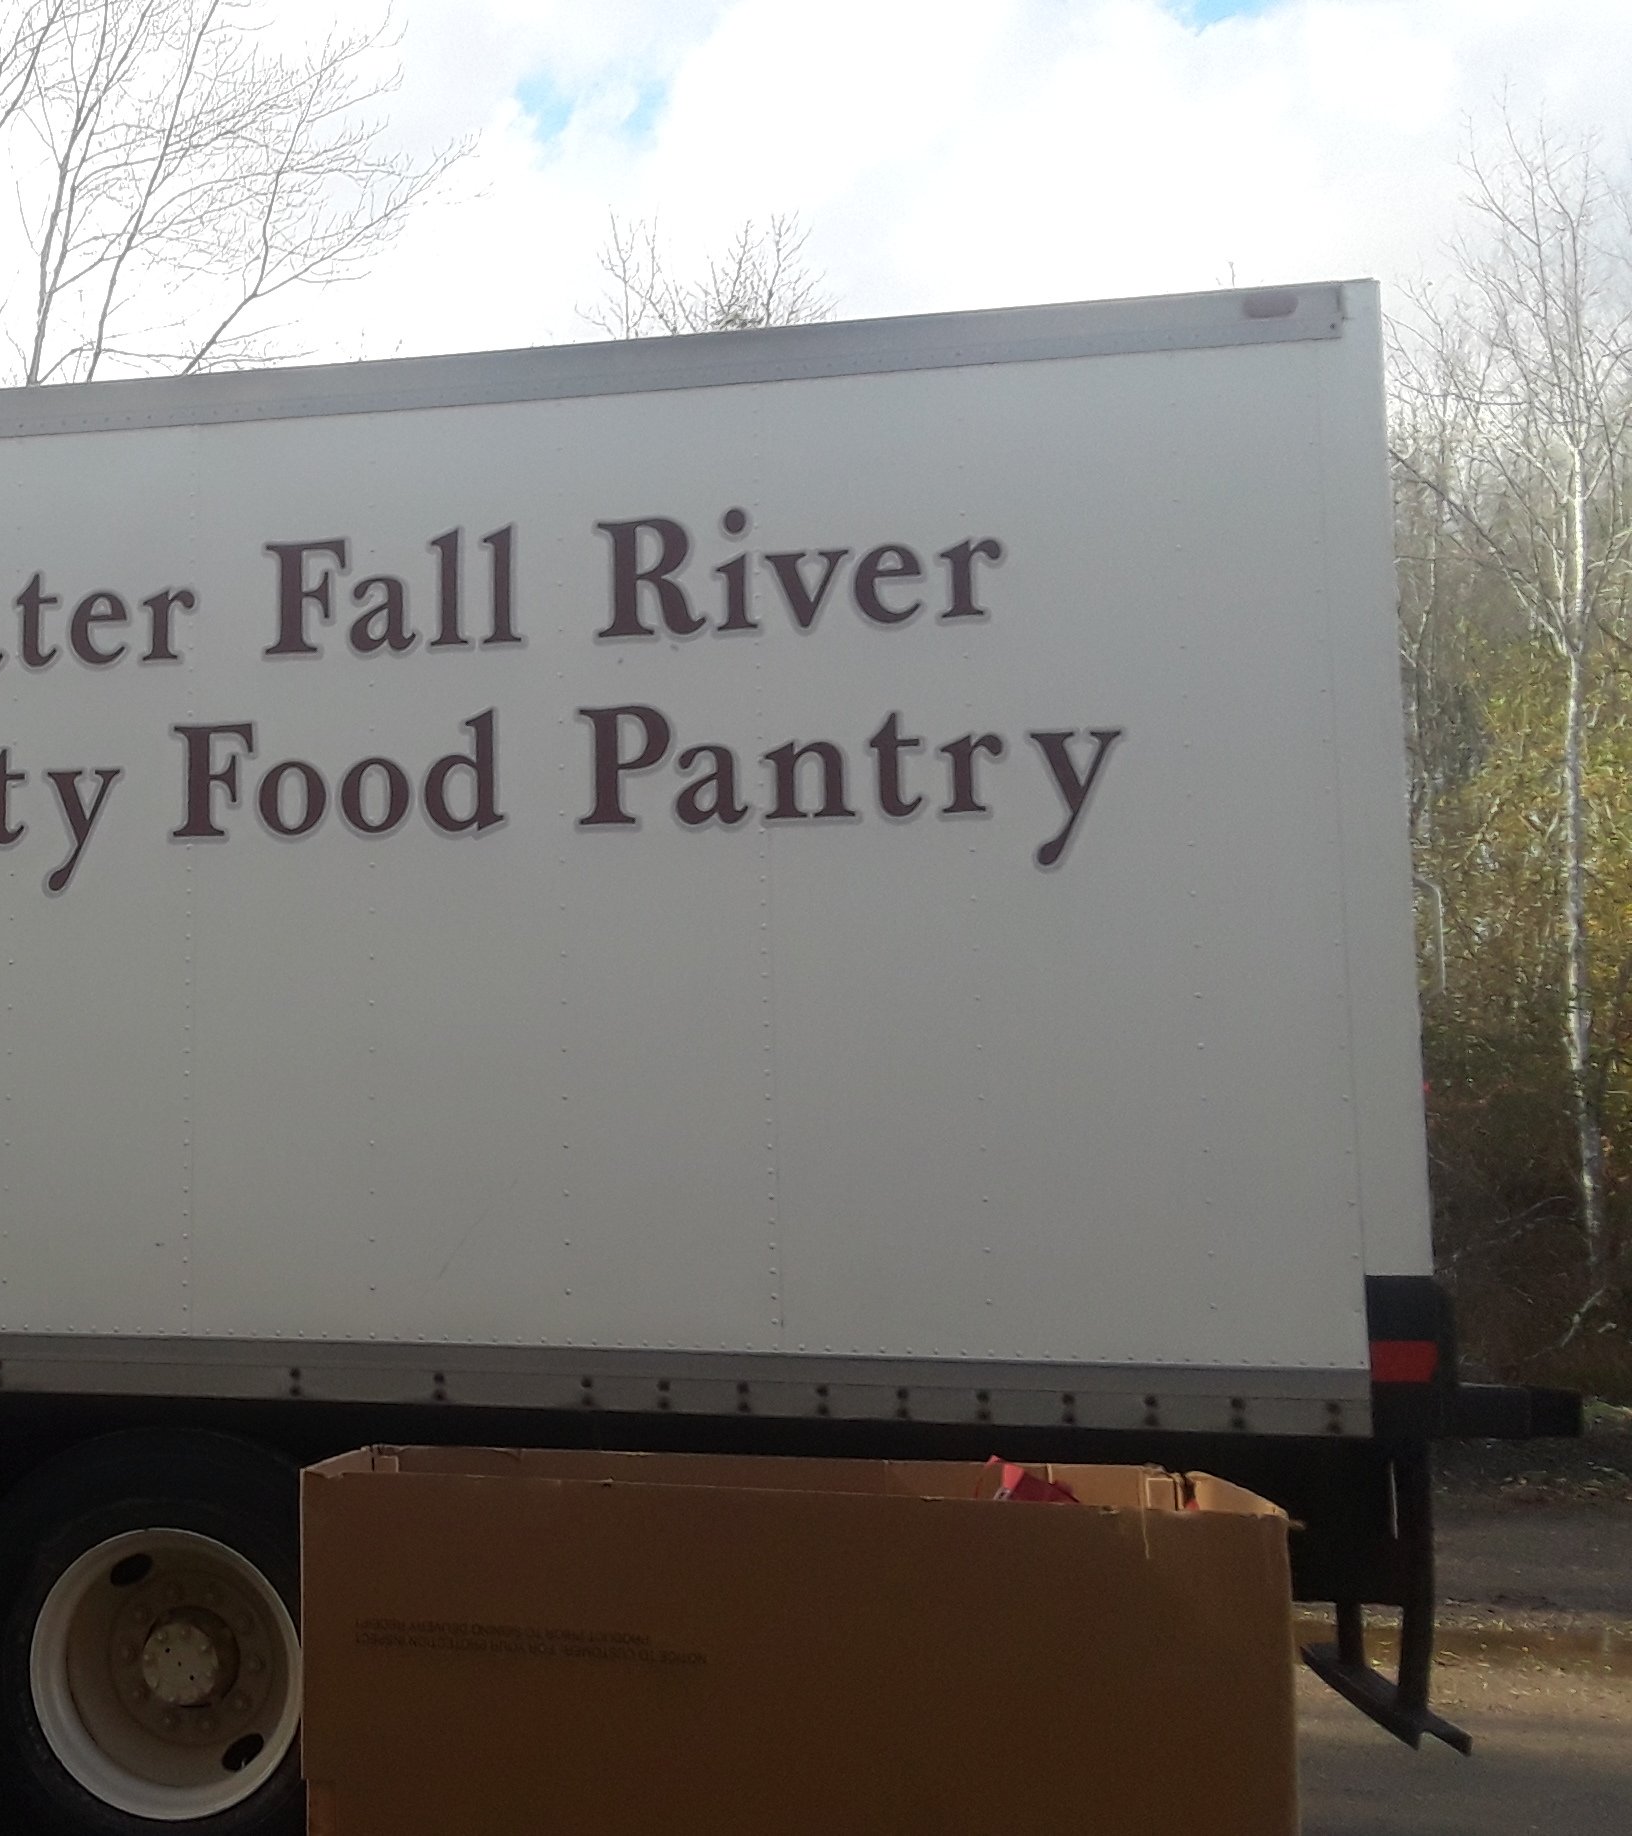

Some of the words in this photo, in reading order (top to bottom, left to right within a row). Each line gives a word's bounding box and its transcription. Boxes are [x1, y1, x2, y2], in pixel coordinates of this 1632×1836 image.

[262, 525, 524, 656] Fall
[595, 507, 1005, 641] River
[172, 707, 506, 840] Food
[576, 703, 1124, 869] Pantry
